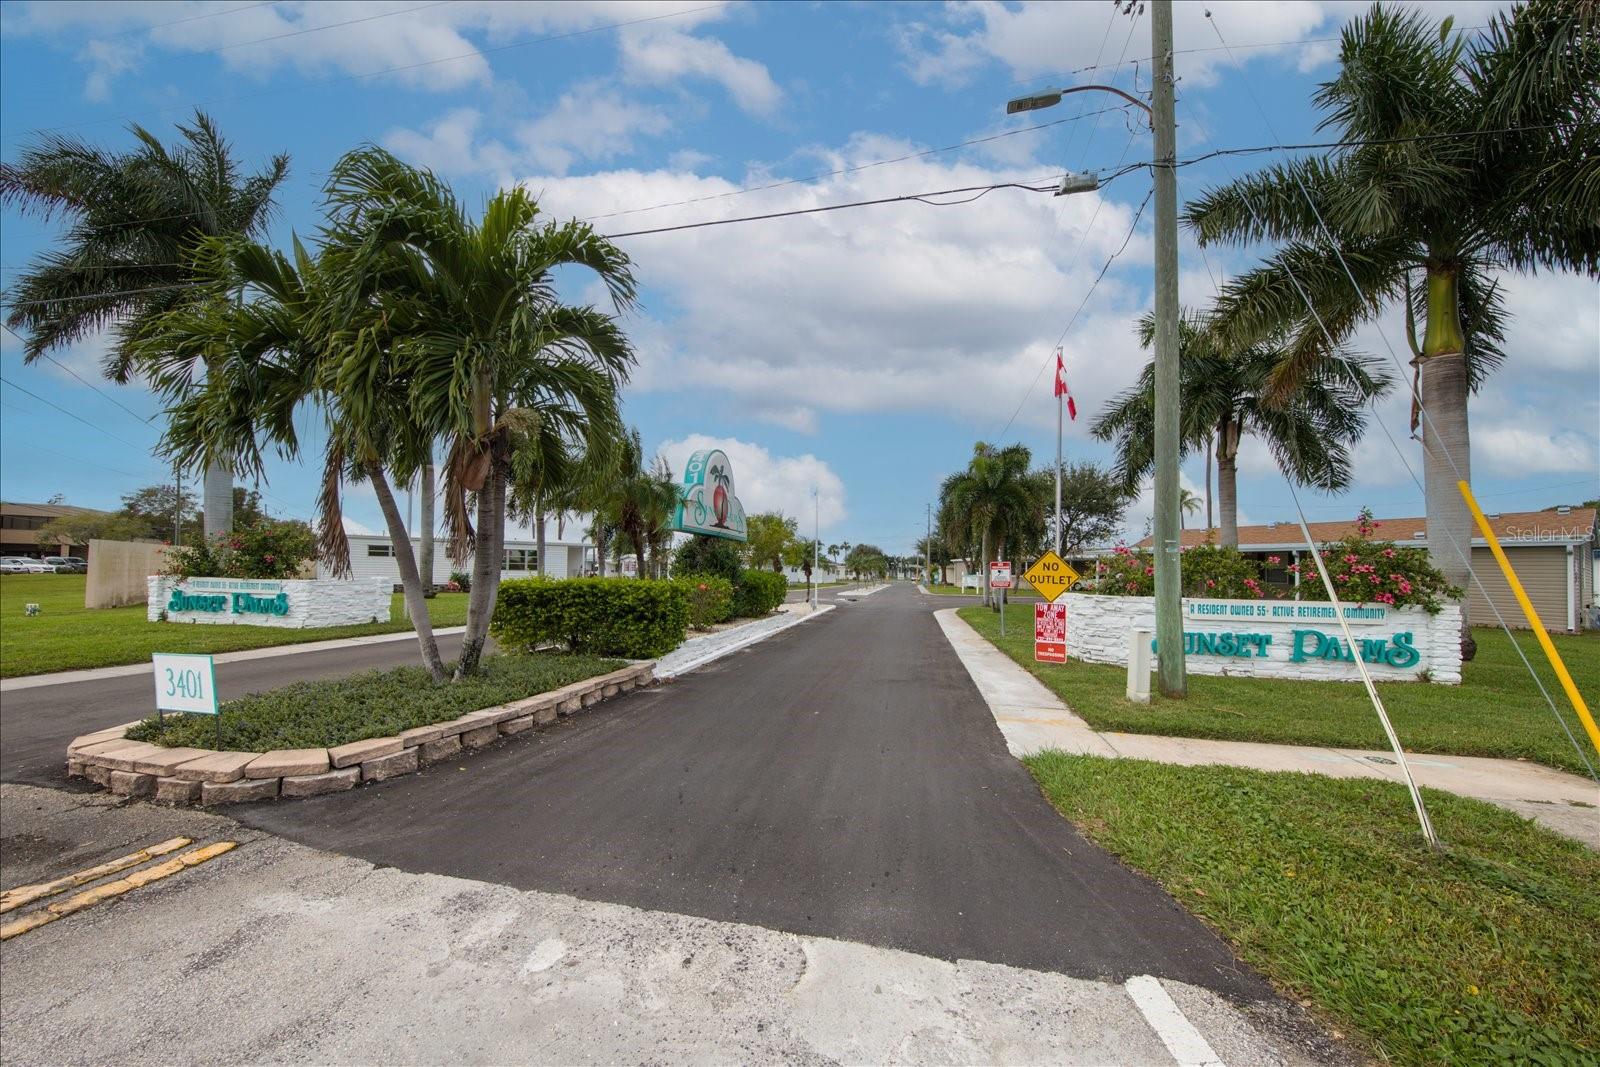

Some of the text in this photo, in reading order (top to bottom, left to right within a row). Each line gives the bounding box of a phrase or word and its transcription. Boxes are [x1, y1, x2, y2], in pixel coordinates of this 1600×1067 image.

[1042, 562, 1059, 571] NO
[1029, 575, 1072, 584] OUTLET
[1197, 604, 1227, 615] RESIDENT
[1230, 605, 1255, 616] OWNED
[1272, 606, 1295, 617] ACTIVE
[1297, 606, 1337, 618] RETIREMEN
[1343, 607, 1386, 619] COMMUNITY
[1151, 631, 1273, 658] UNSET
[165, 668, 204, 699] 3401
